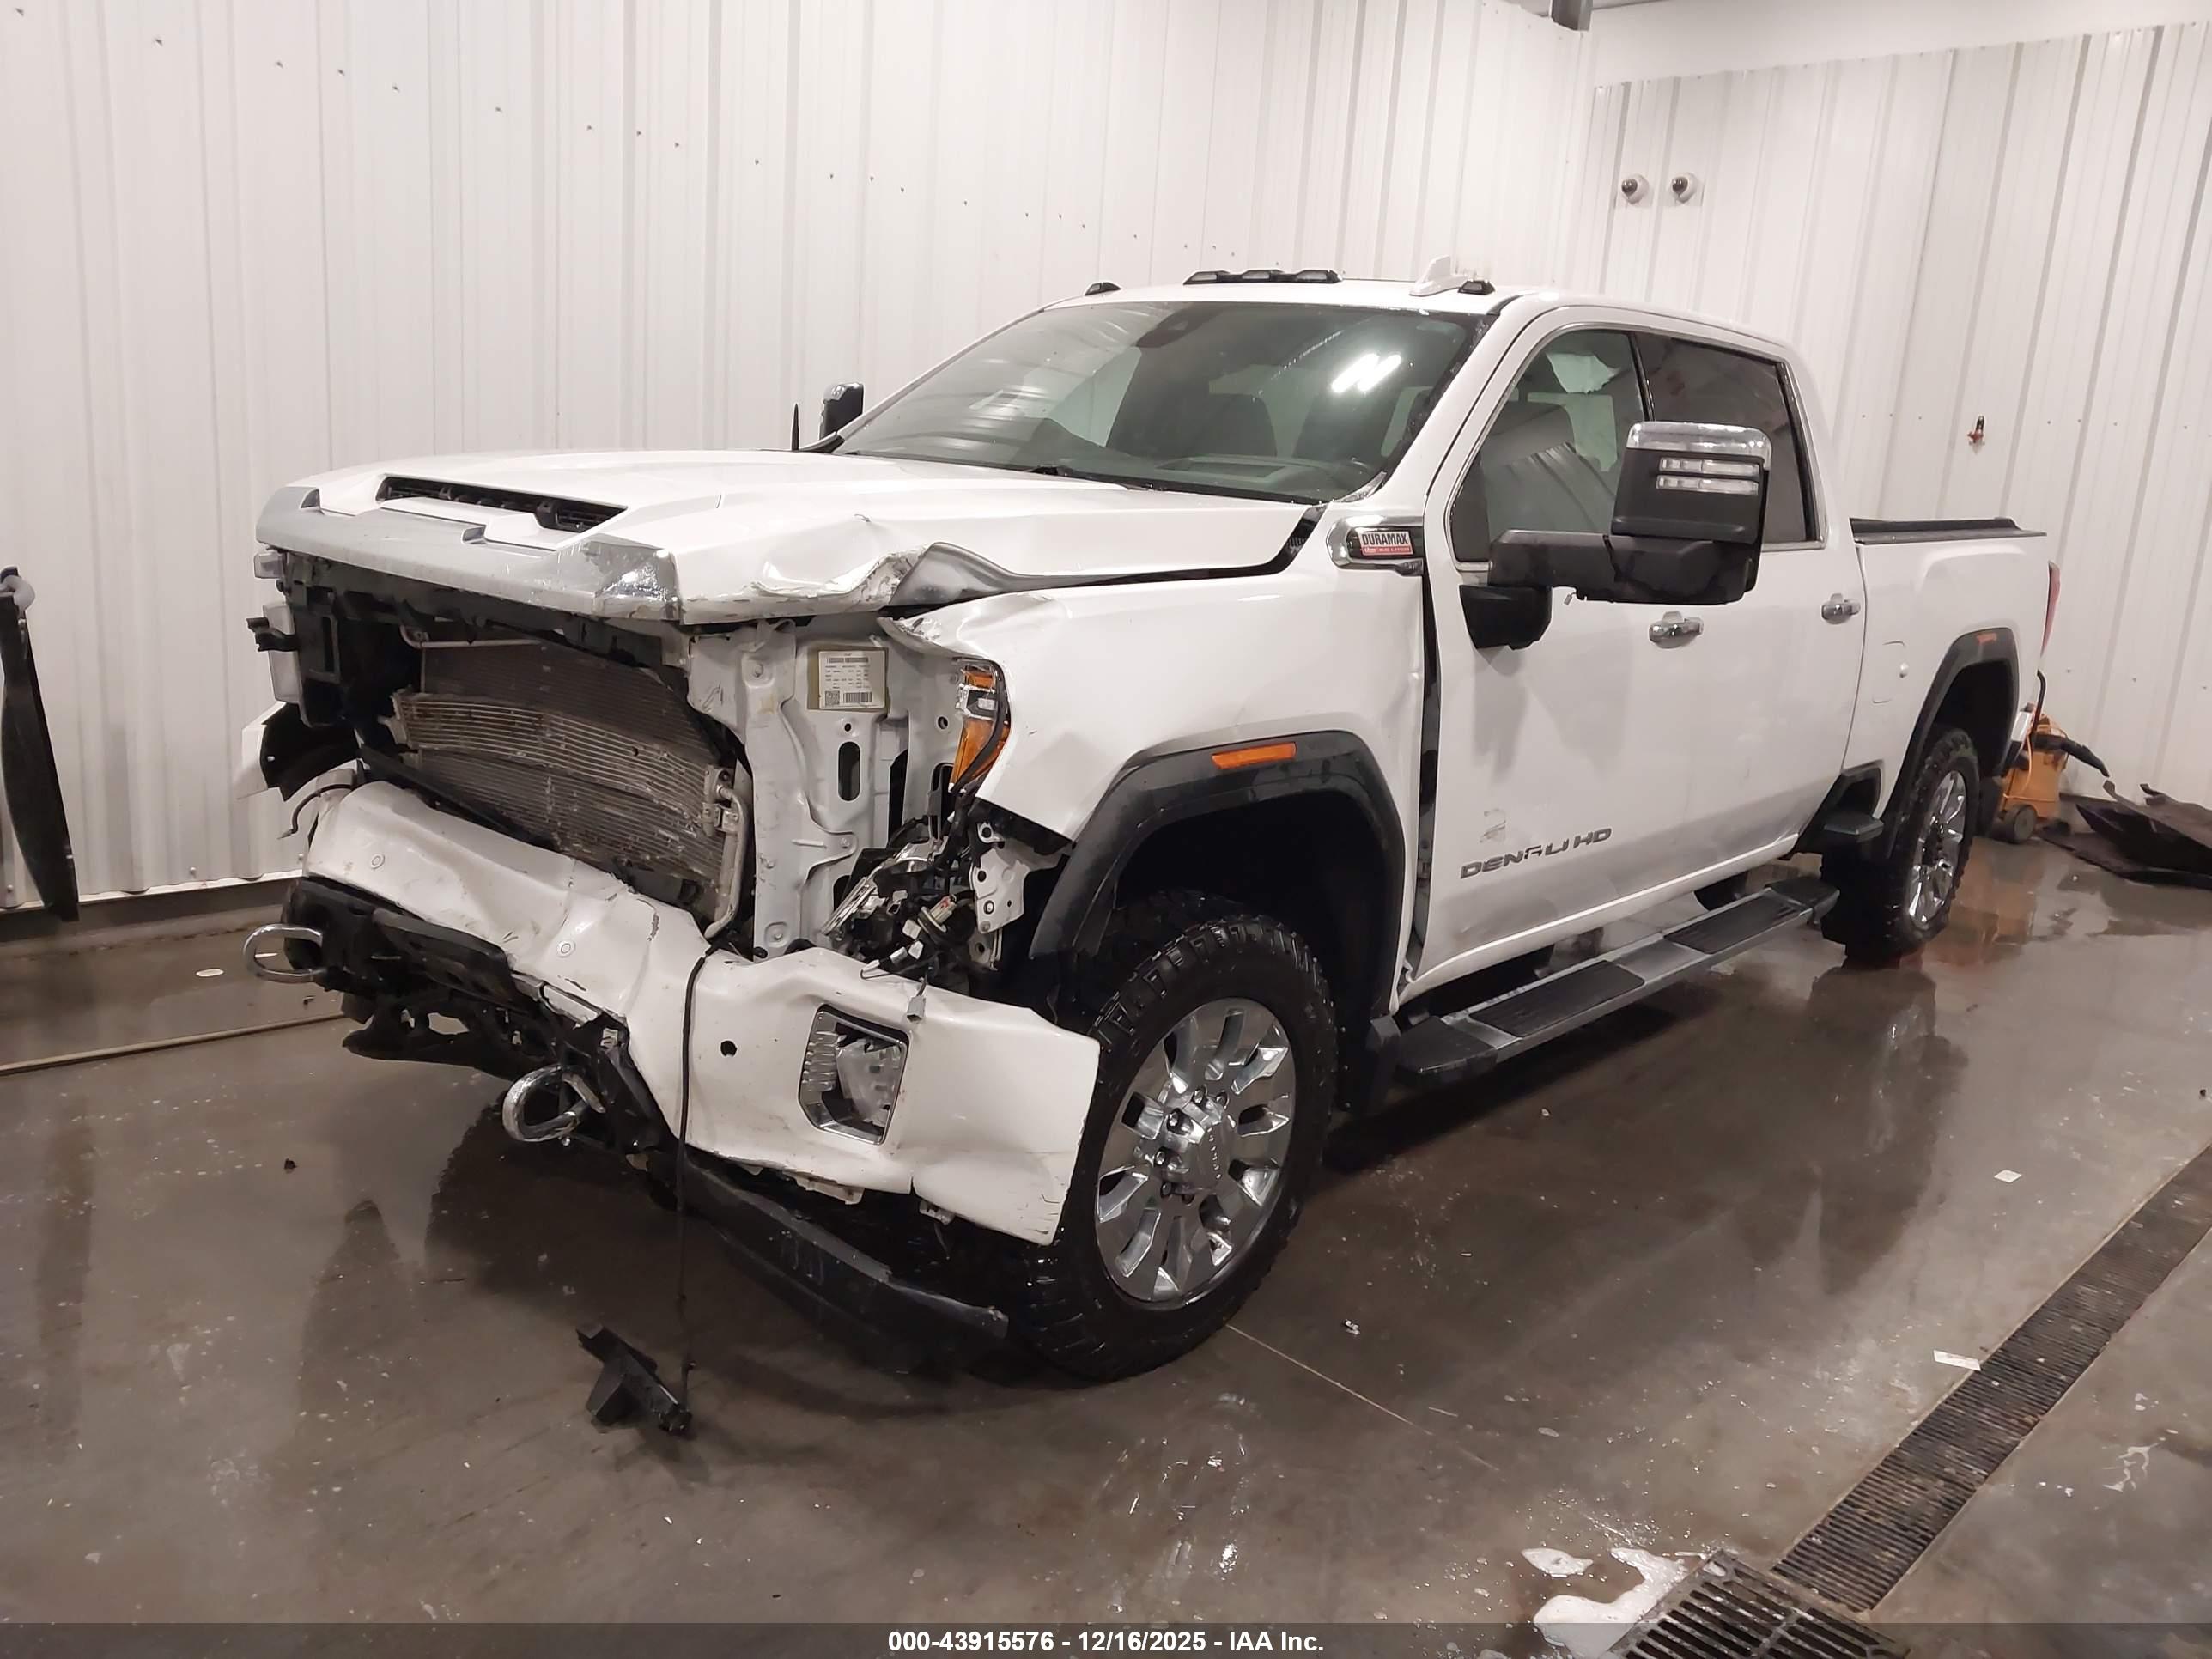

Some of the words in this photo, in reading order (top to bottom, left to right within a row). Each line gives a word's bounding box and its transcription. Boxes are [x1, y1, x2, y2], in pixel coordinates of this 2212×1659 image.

[1361, 533, 1408, 545] DURAMAX
[1460, 838, 1570, 879] DENALI
[1573, 828, 1612, 848] HD
